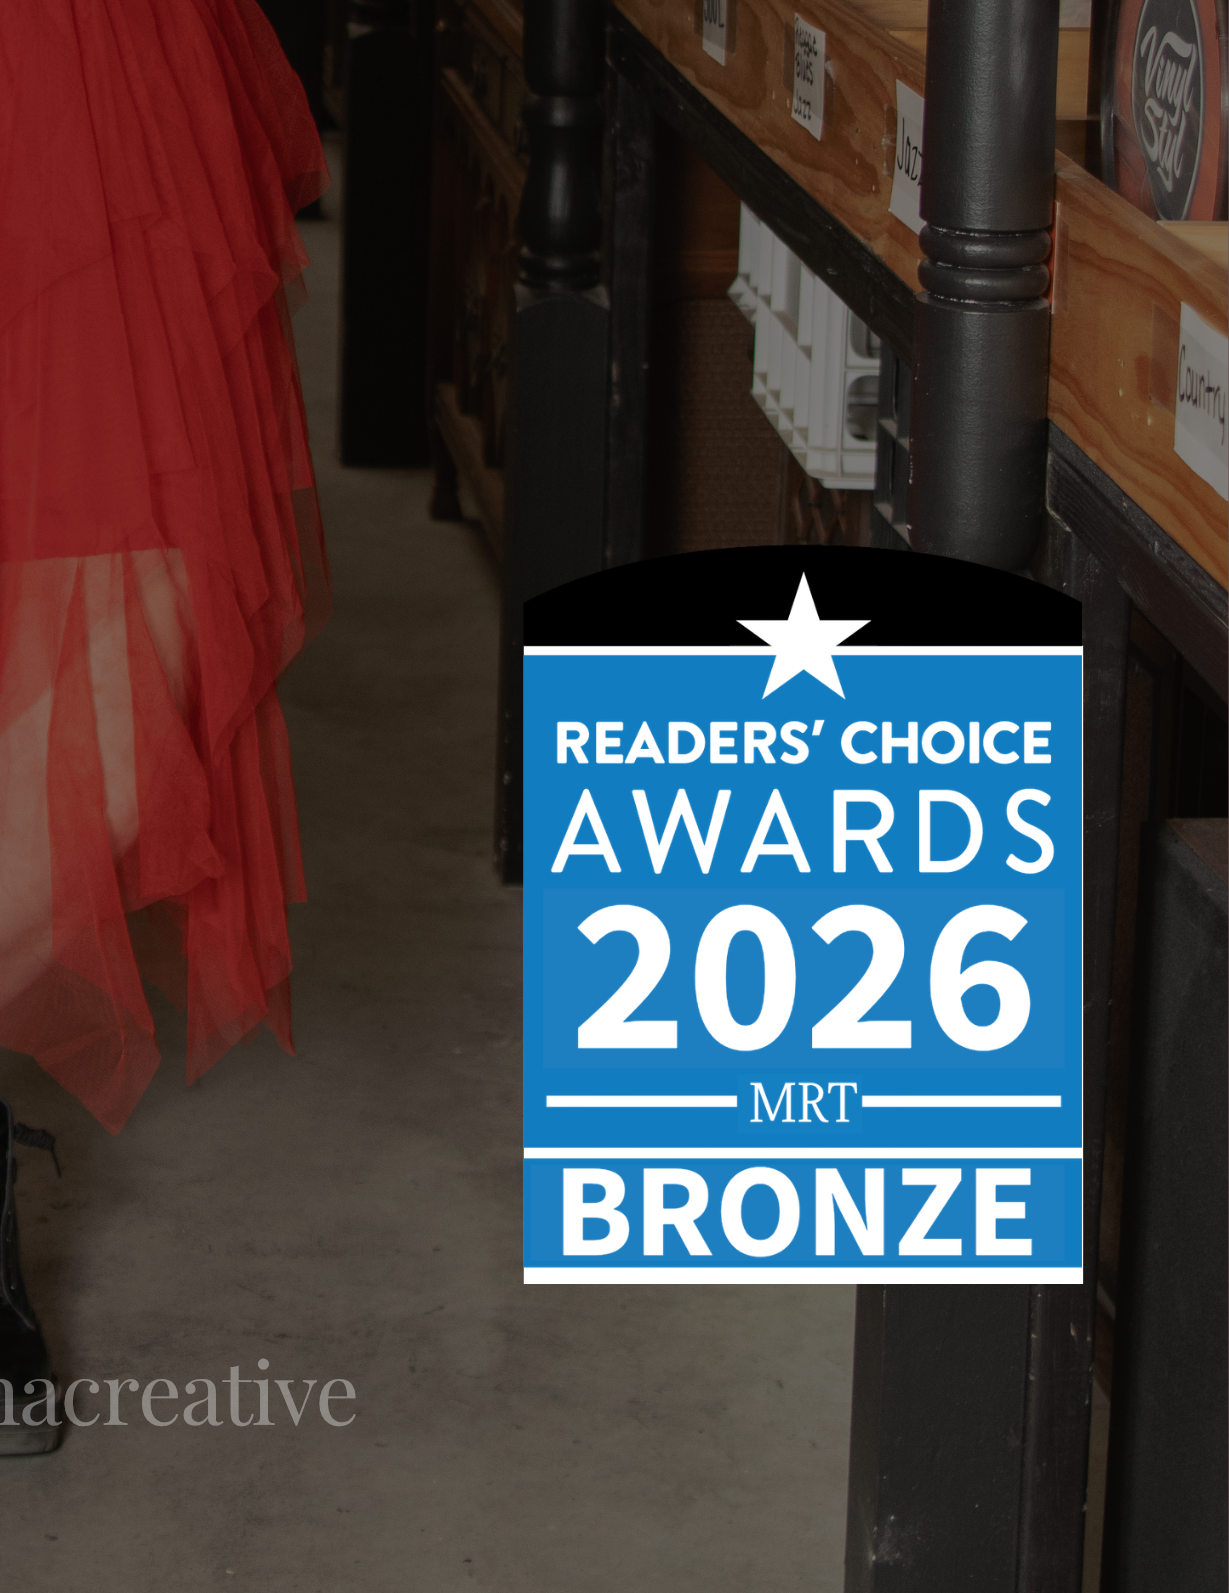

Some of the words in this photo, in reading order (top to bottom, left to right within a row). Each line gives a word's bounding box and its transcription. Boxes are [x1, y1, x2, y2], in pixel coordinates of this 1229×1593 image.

[1140, 25, 1197, 127] Vinyl
[1141, 98, 1187, 193] Styl
[1178, 344, 1226, 446] Country
